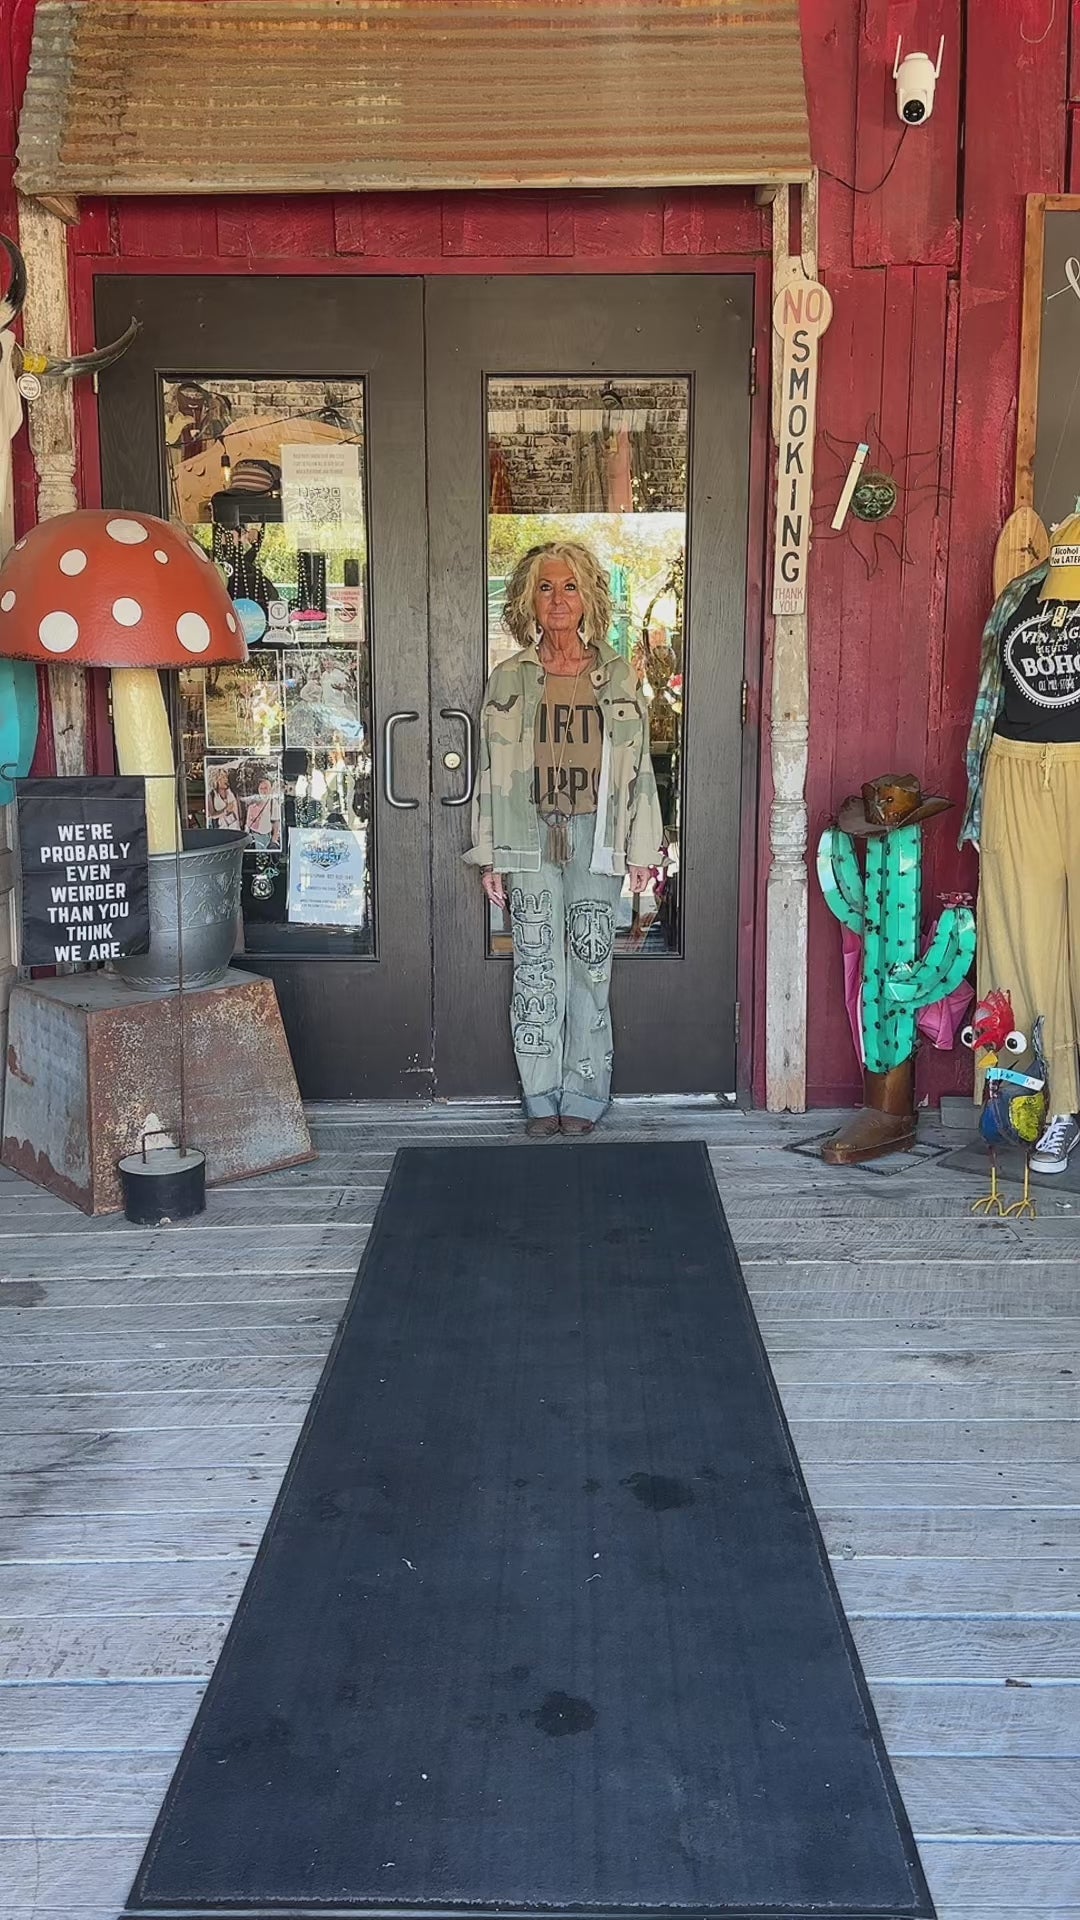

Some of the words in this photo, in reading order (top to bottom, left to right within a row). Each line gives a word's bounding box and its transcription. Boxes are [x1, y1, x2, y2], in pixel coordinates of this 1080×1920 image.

[783, 288, 825, 325] NO
[780, 329, 811, 583] SMOKING
[774, 587, 804, 600] THANK
[779, 600, 798, 613] YOU
[57, 823, 114, 842] WE'RE
[40, 842, 130, 864] PROBABLY
[66, 864, 111, 882] EVEN
[50, 882, 126, 903] WEIRDER
[47, 906, 94, 924] THAN
[98, 901, 130, 919] YOU
[66, 922, 114, 942] THINK
[54, 945, 82, 962] WE
[88, 941, 126, 961] ARE.
